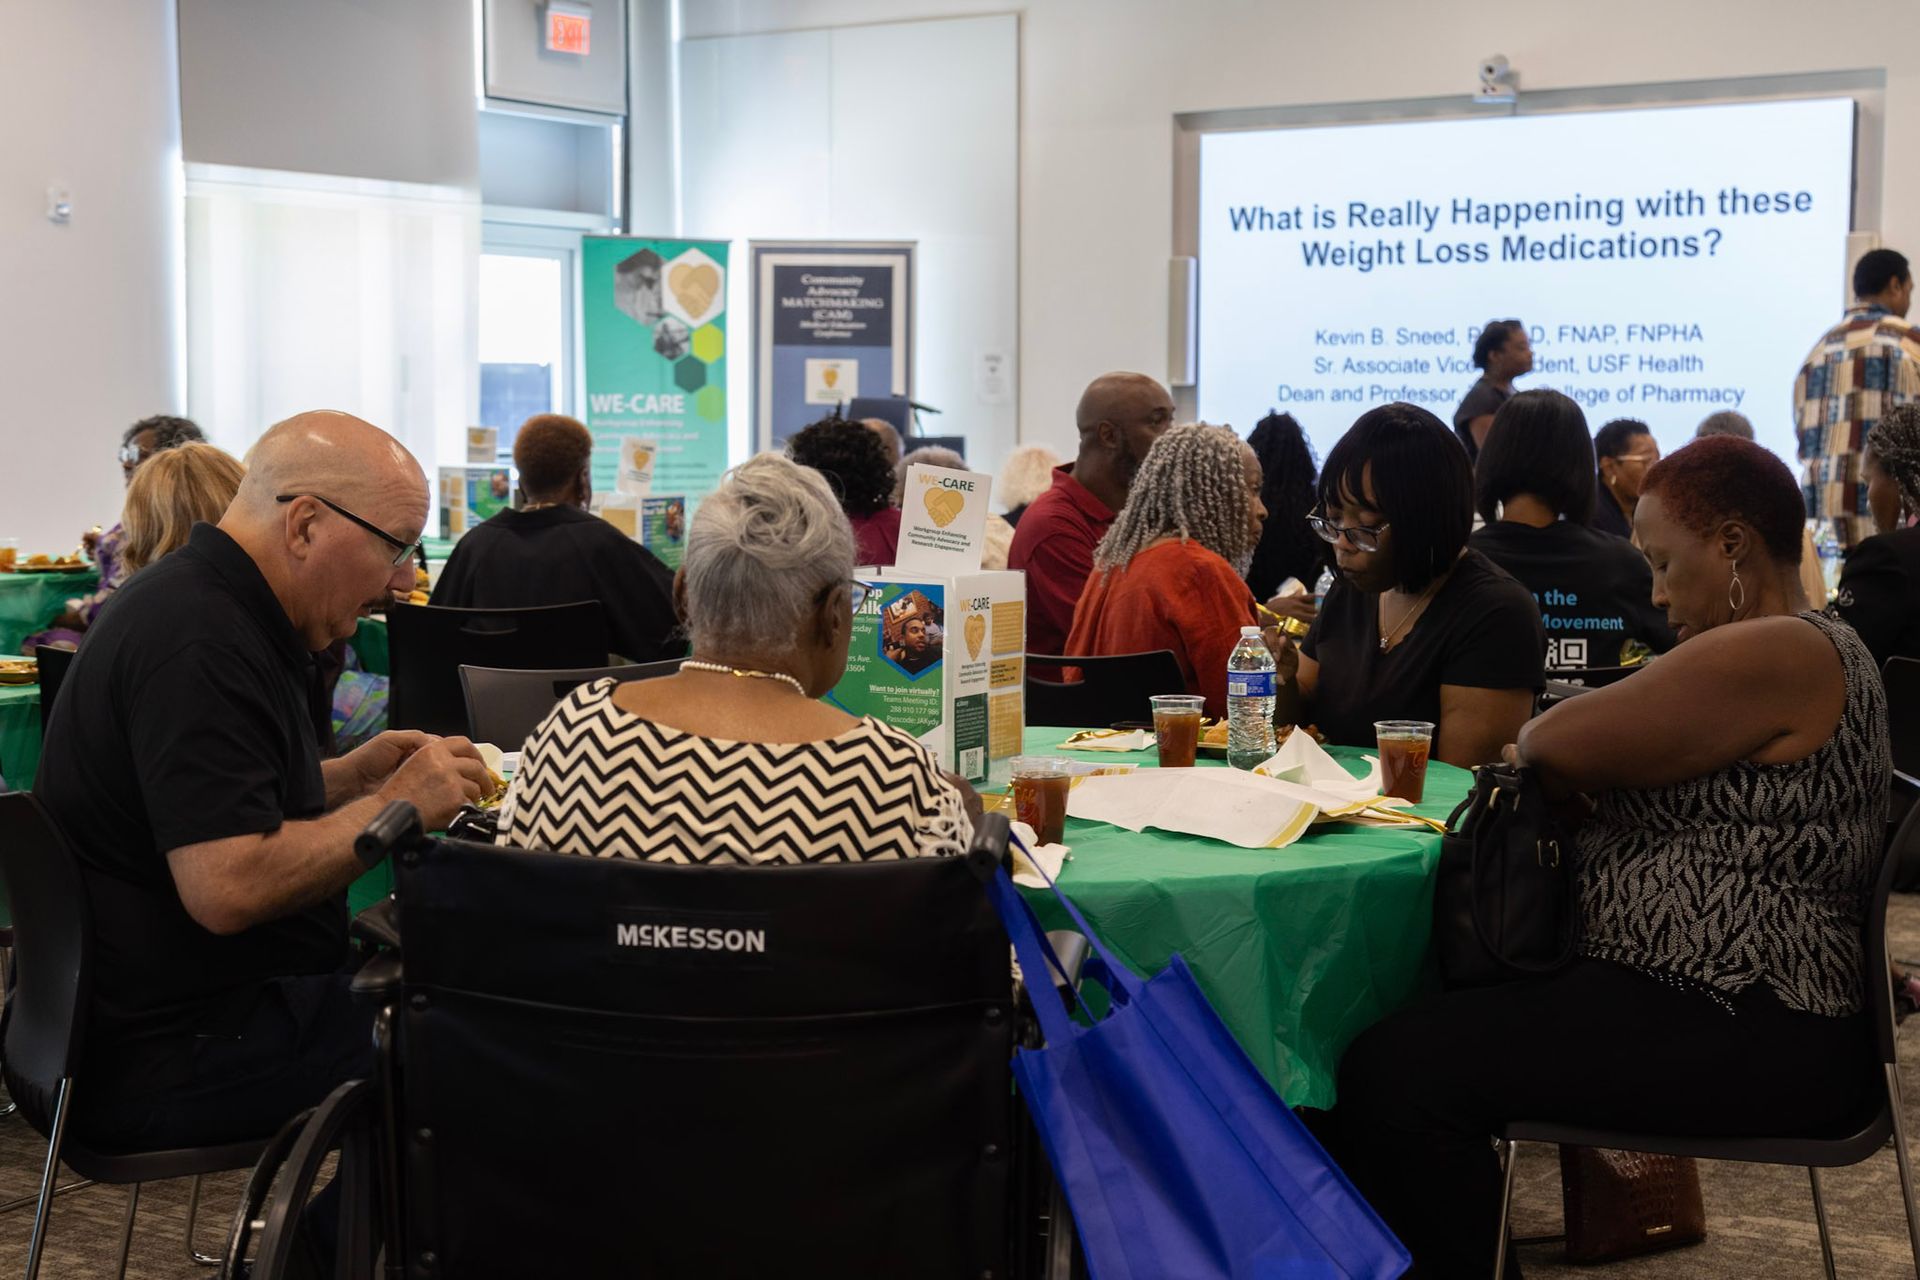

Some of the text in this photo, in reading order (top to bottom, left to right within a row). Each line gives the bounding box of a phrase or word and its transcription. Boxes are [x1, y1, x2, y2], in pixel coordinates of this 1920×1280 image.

[1229, 187, 1813, 233] What is Really Happening with these
[1302, 228, 1723, 273] Weight Loss Medications?
[1315, 329, 1365, 346] Kevin
[1396, 327, 1461, 347] Sneed,
[1557, 325, 1619, 344] FNAP,
[1627, 323, 1704, 343] FNPHA
[1342, 357, 1430, 374] Associate
[1587, 354, 1630, 374] USF
[1639, 353, 1704, 373] Health
[590, 393, 687, 415] WE-CARE
[1278, 384, 1324, 402] Dean
[1331, 384, 1363, 402] and
[1370, 384, 1461, 406] Professor,
[1617, 384, 1636, 402] of
[1642, 384, 1745, 408] Pharmacy
[918, 473, 976, 492] WE-CARE
[907, 531, 936, 542] Community
[913, 525, 967, 540] Workgroup Enhancing
[960, 597, 990, 612] WE-CARE
[1544, 589, 1577, 606] the
[869, 684, 886, 693] Want
